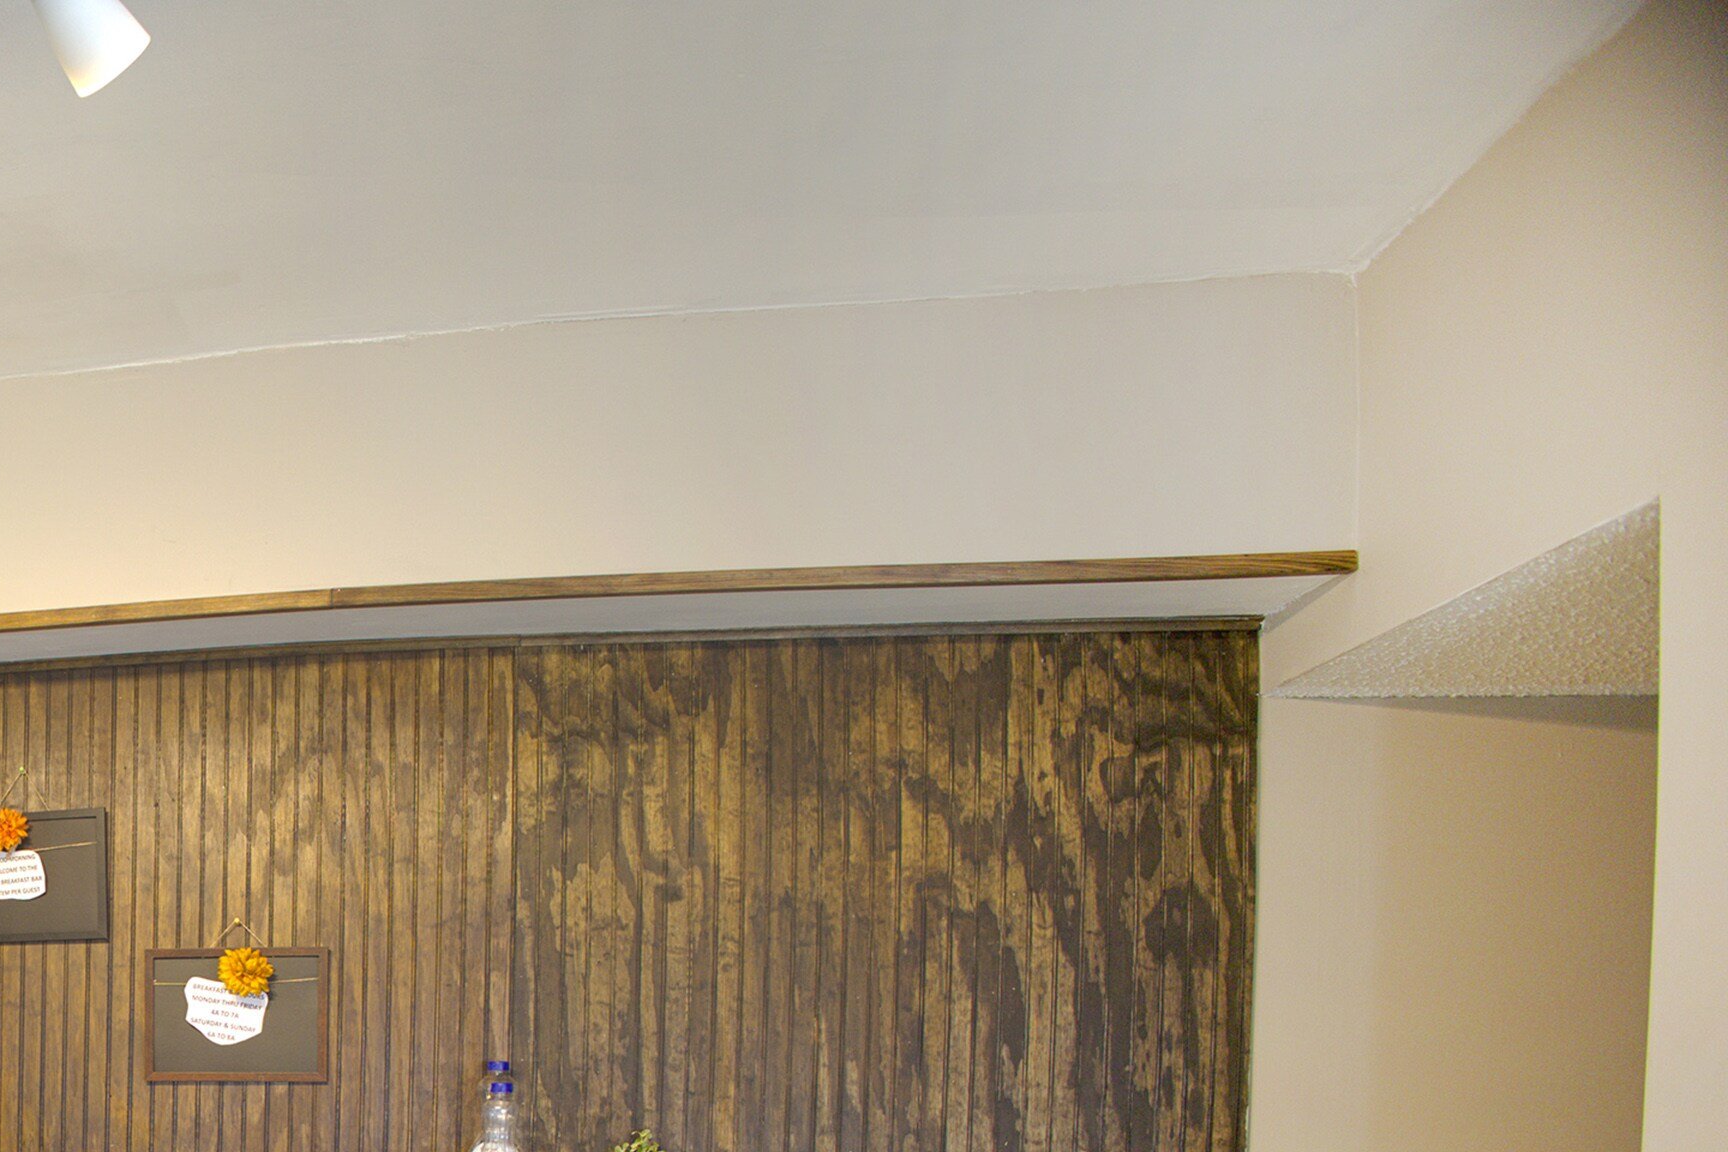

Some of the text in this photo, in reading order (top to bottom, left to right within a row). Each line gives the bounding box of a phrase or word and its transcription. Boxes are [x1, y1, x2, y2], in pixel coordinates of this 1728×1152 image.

[1, 876, 30, 885] BREAKFAST
[192, 983, 227, 994] BREAKFAST
[192, 994, 263, 1010] MONDAY THRU FRIDAY
[191, 1017, 222, 1027] SATURDAY
[230, 1023, 256, 1033] SUNDAY
[217, 1032, 226, 1040] TO
